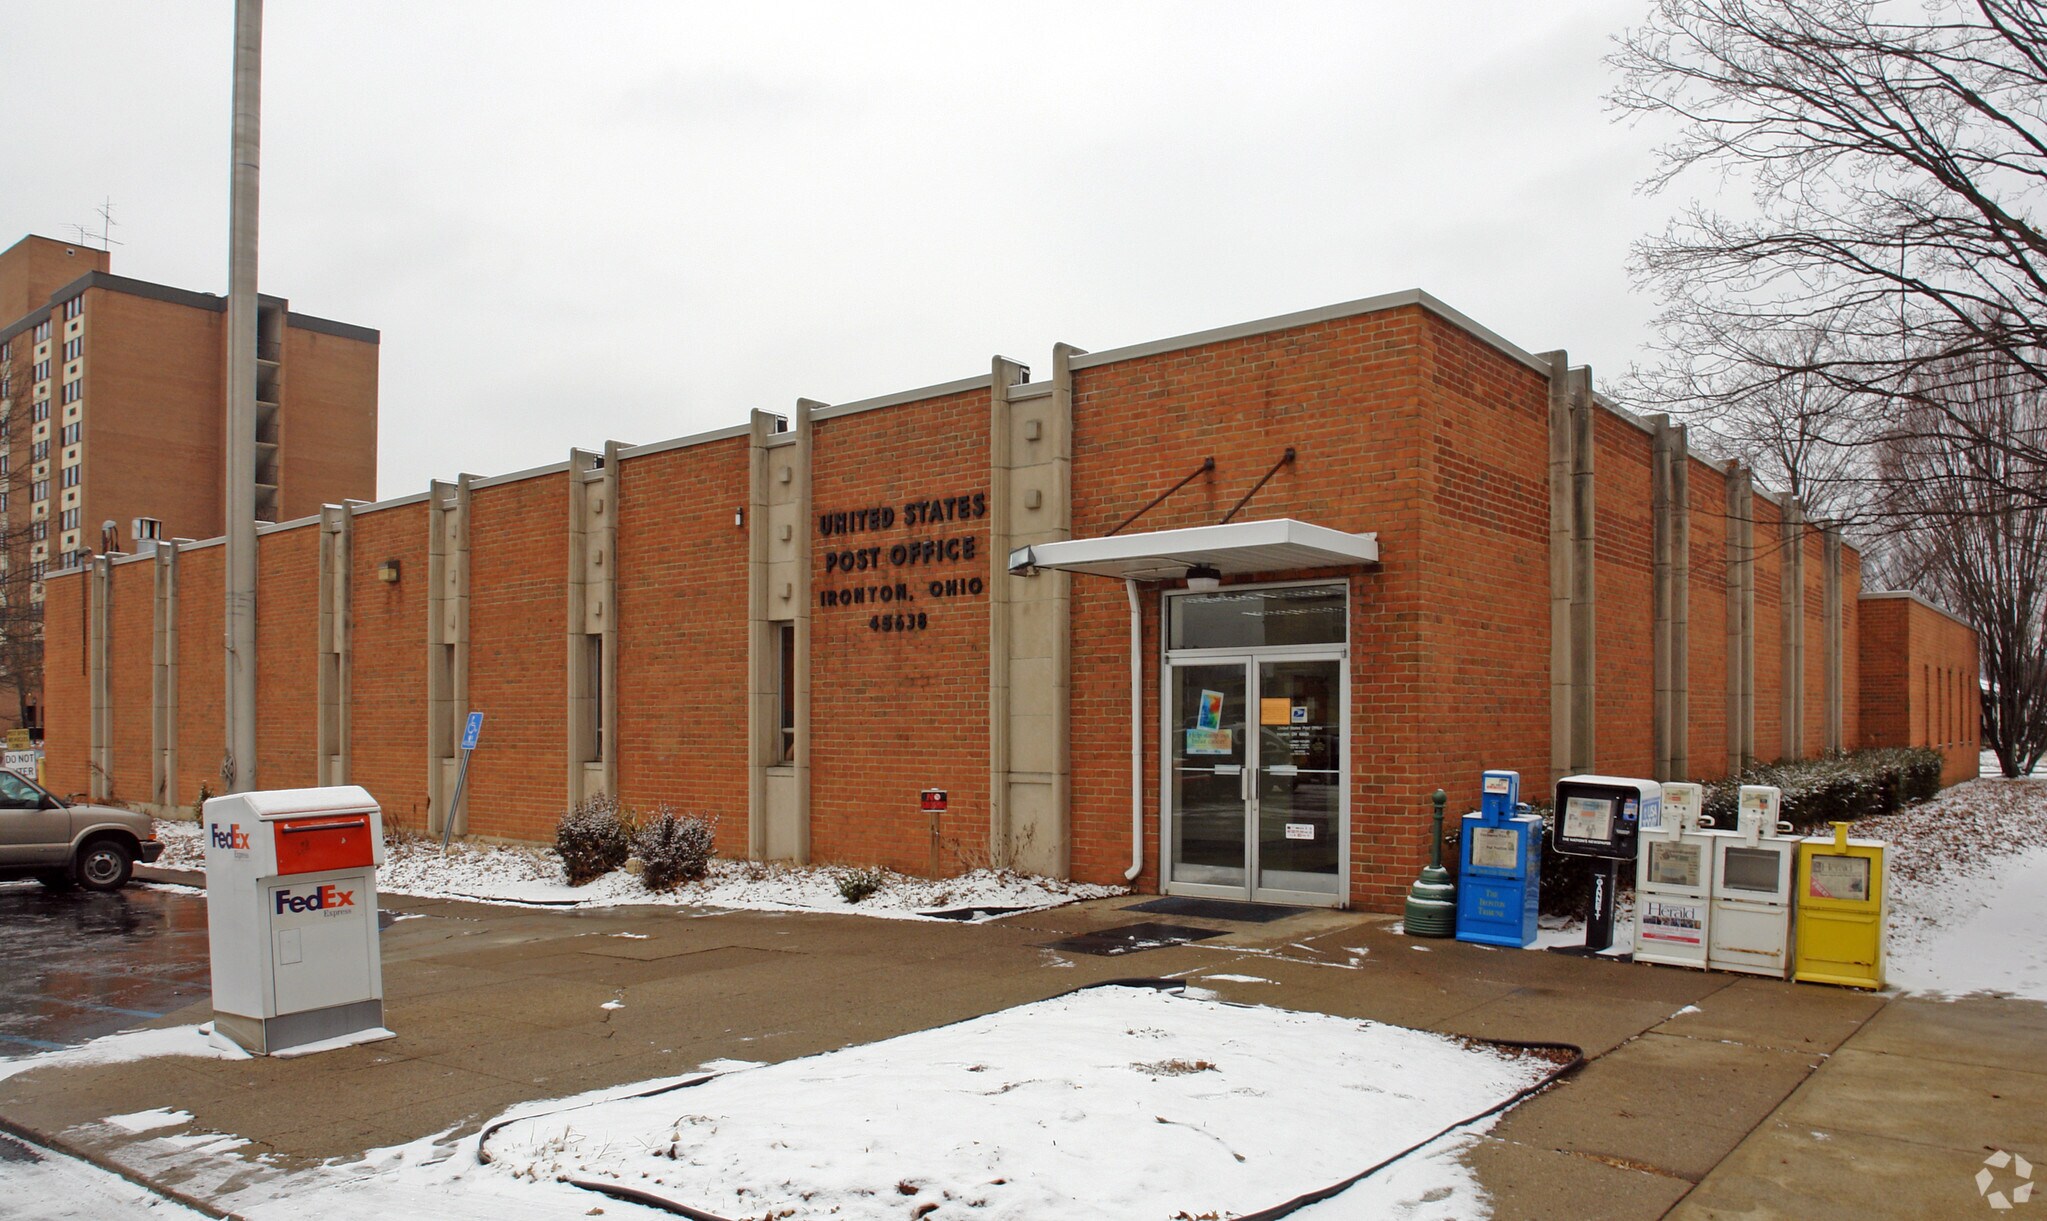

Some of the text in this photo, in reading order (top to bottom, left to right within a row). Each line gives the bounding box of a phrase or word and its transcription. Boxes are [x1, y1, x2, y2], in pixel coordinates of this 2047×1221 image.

[820, 493, 986, 535] UNITED STATES
[826, 536, 974, 573] POST OFFICE
[820, 577, 983, 606] IRONTON, OHIO
[869, 612, 927, 631] 45638
[6, 754, 33, 763] DO NOT
[16, 767, 33, 775] TER
[211, 823, 251, 849] FedEx
[276, 884, 355, 914] FedEx
[324, 909, 352, 918] Express
[1649, 902, 1695, 919] Herald
